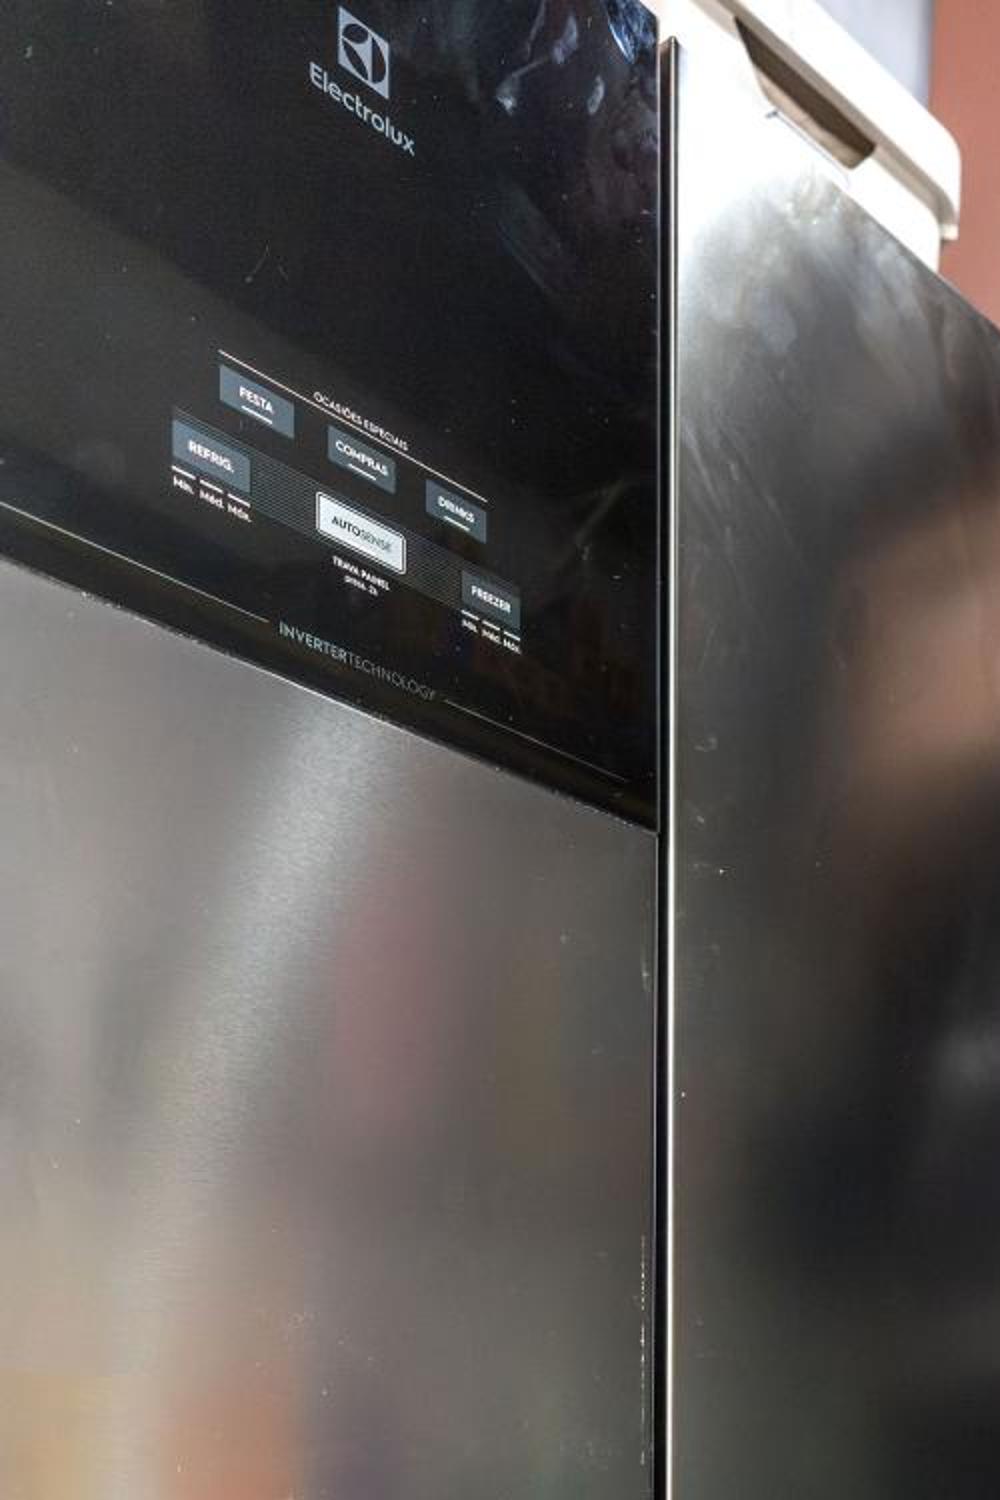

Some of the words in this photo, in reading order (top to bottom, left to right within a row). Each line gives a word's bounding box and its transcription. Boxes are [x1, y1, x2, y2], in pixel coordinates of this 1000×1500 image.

[309, 61, 415, 156] Electrolux
[239, 385, 275, 415] FESTA
[187, 440, 235, 474] REFRIG.
[335, 440, 389, 476] COMPRAS
[331, 516, 392, 553] AUTOSENSE
[471, 584, 511, 614] FREEZER
